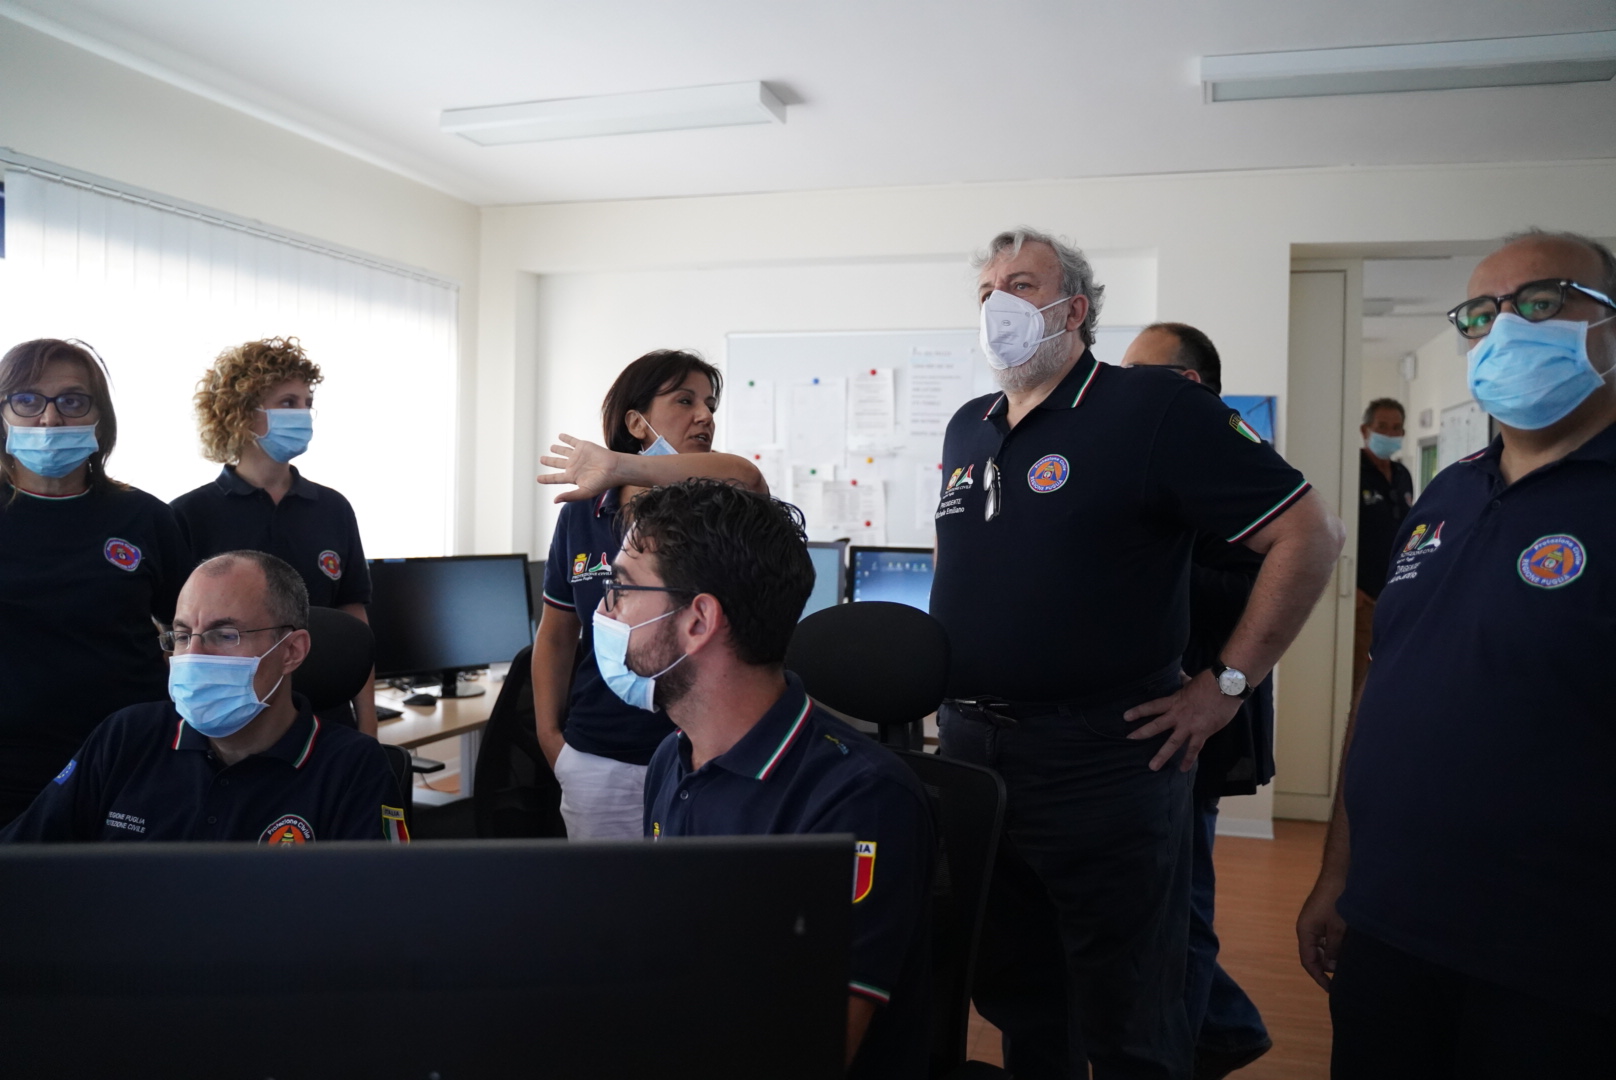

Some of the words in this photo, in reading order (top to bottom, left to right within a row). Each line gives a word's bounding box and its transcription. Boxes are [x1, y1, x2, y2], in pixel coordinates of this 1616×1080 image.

[1533, 537, 1574, 550] Protezione
[1572, 546, 1582, 566] Civile
[1521, 558, 1541, 583] REGIONE
[1540, 574, 1571, 586] PUGLIA
[125, 814, 146, 825] PUGLIA
[127, 823, 146, 833] CIVILE
[267, 818, 298, 835] Protezione
[297, 821, 311, 840] Civile
